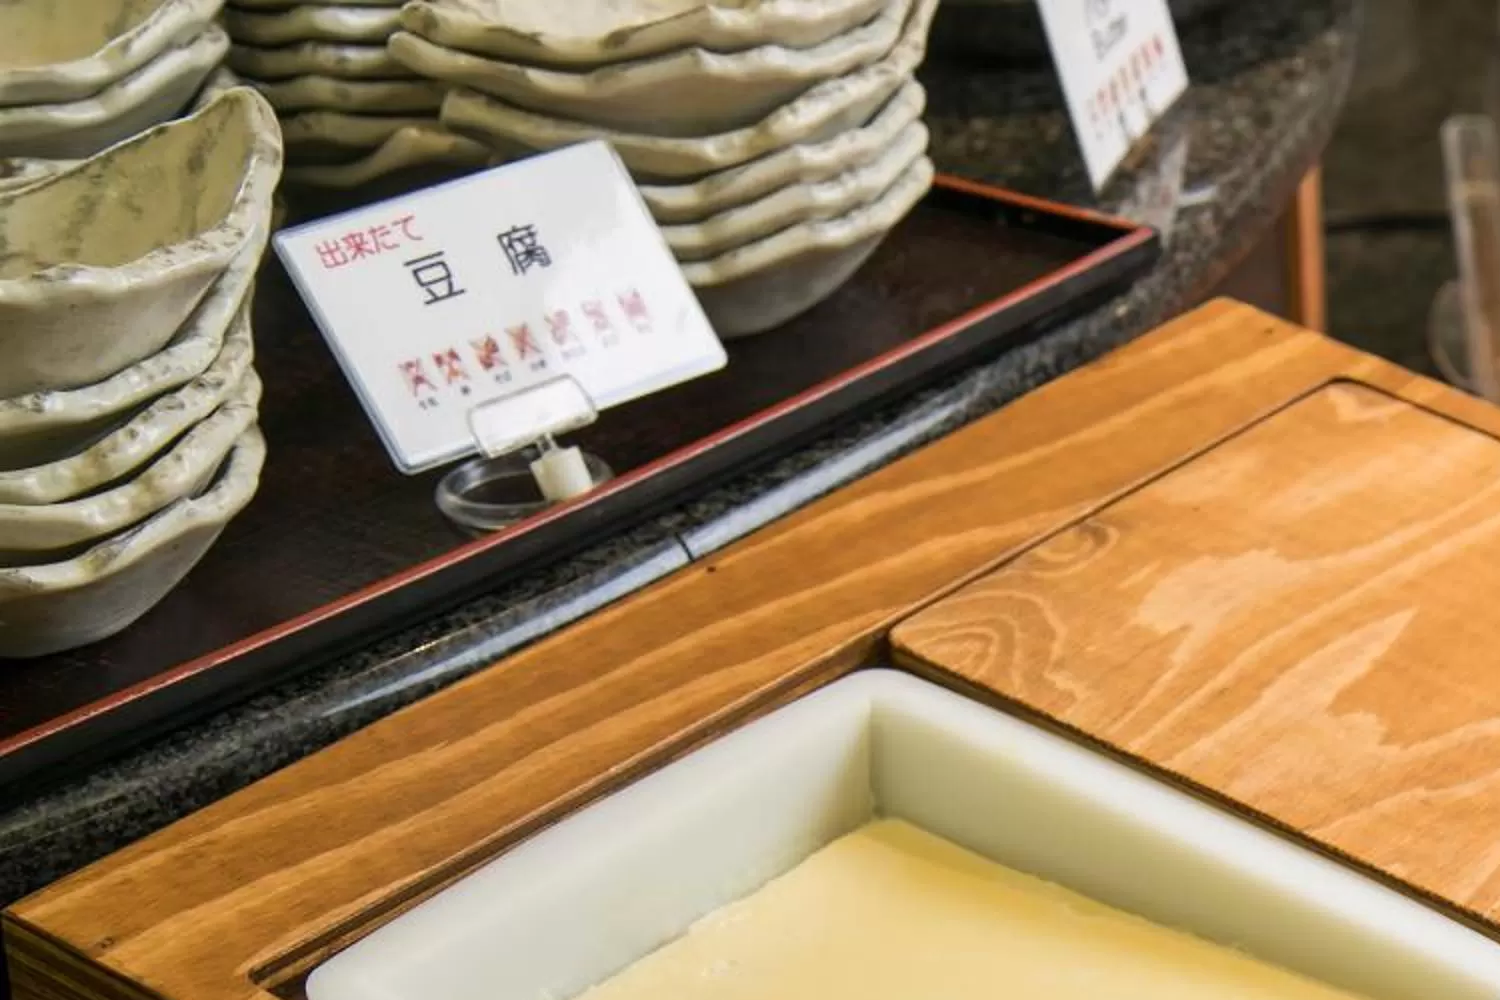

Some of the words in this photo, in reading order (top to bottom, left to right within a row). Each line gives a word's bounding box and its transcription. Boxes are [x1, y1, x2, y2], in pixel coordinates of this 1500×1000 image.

[315, 214, 424, 270] 出来たて
[403, 223, 553, 305] 豆腐
